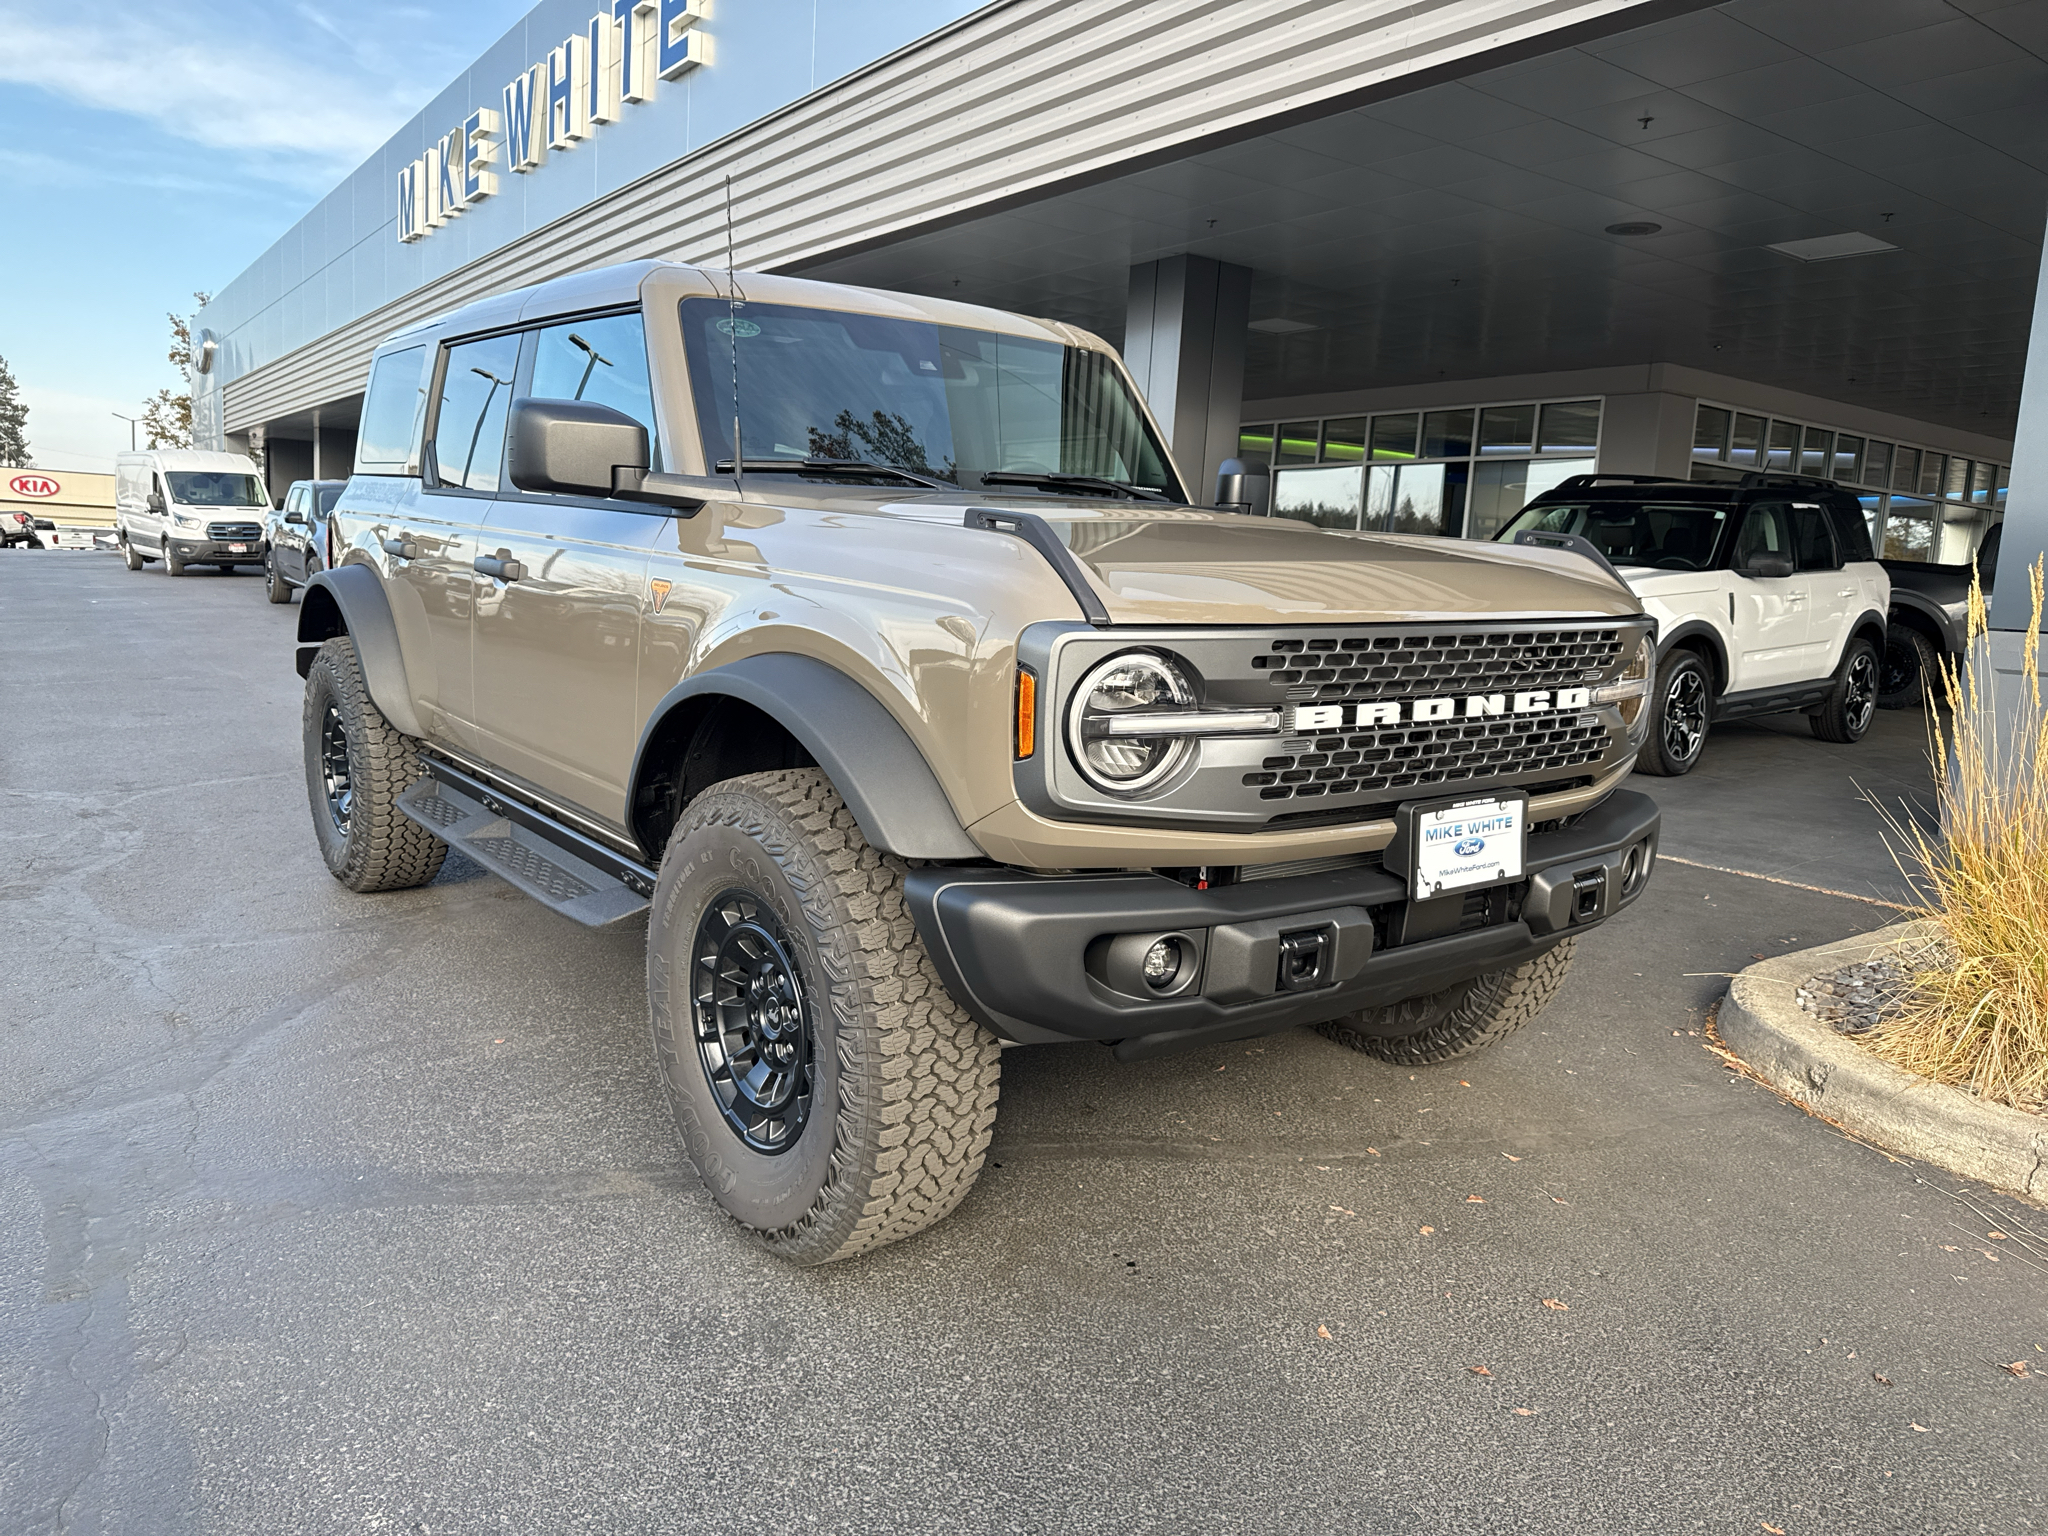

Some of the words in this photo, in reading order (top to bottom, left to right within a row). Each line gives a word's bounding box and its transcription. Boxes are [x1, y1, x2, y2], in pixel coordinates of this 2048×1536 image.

[398, 107, 489, 243] MIKE
[503, 0, 701, 173] WHITE
[18, 479, 52, 493] KIA
[1294, 687, 1590, 732] BRONCO
[1425, 824, 1463, 842] MIKE
[1467, 816, 1513, 835] WHITE
[1458, 839, 1481, 855] Ford
[700, 850, 714, 865] RT
[1438, 861, 1500, 877] MikeWhiteFord.com
